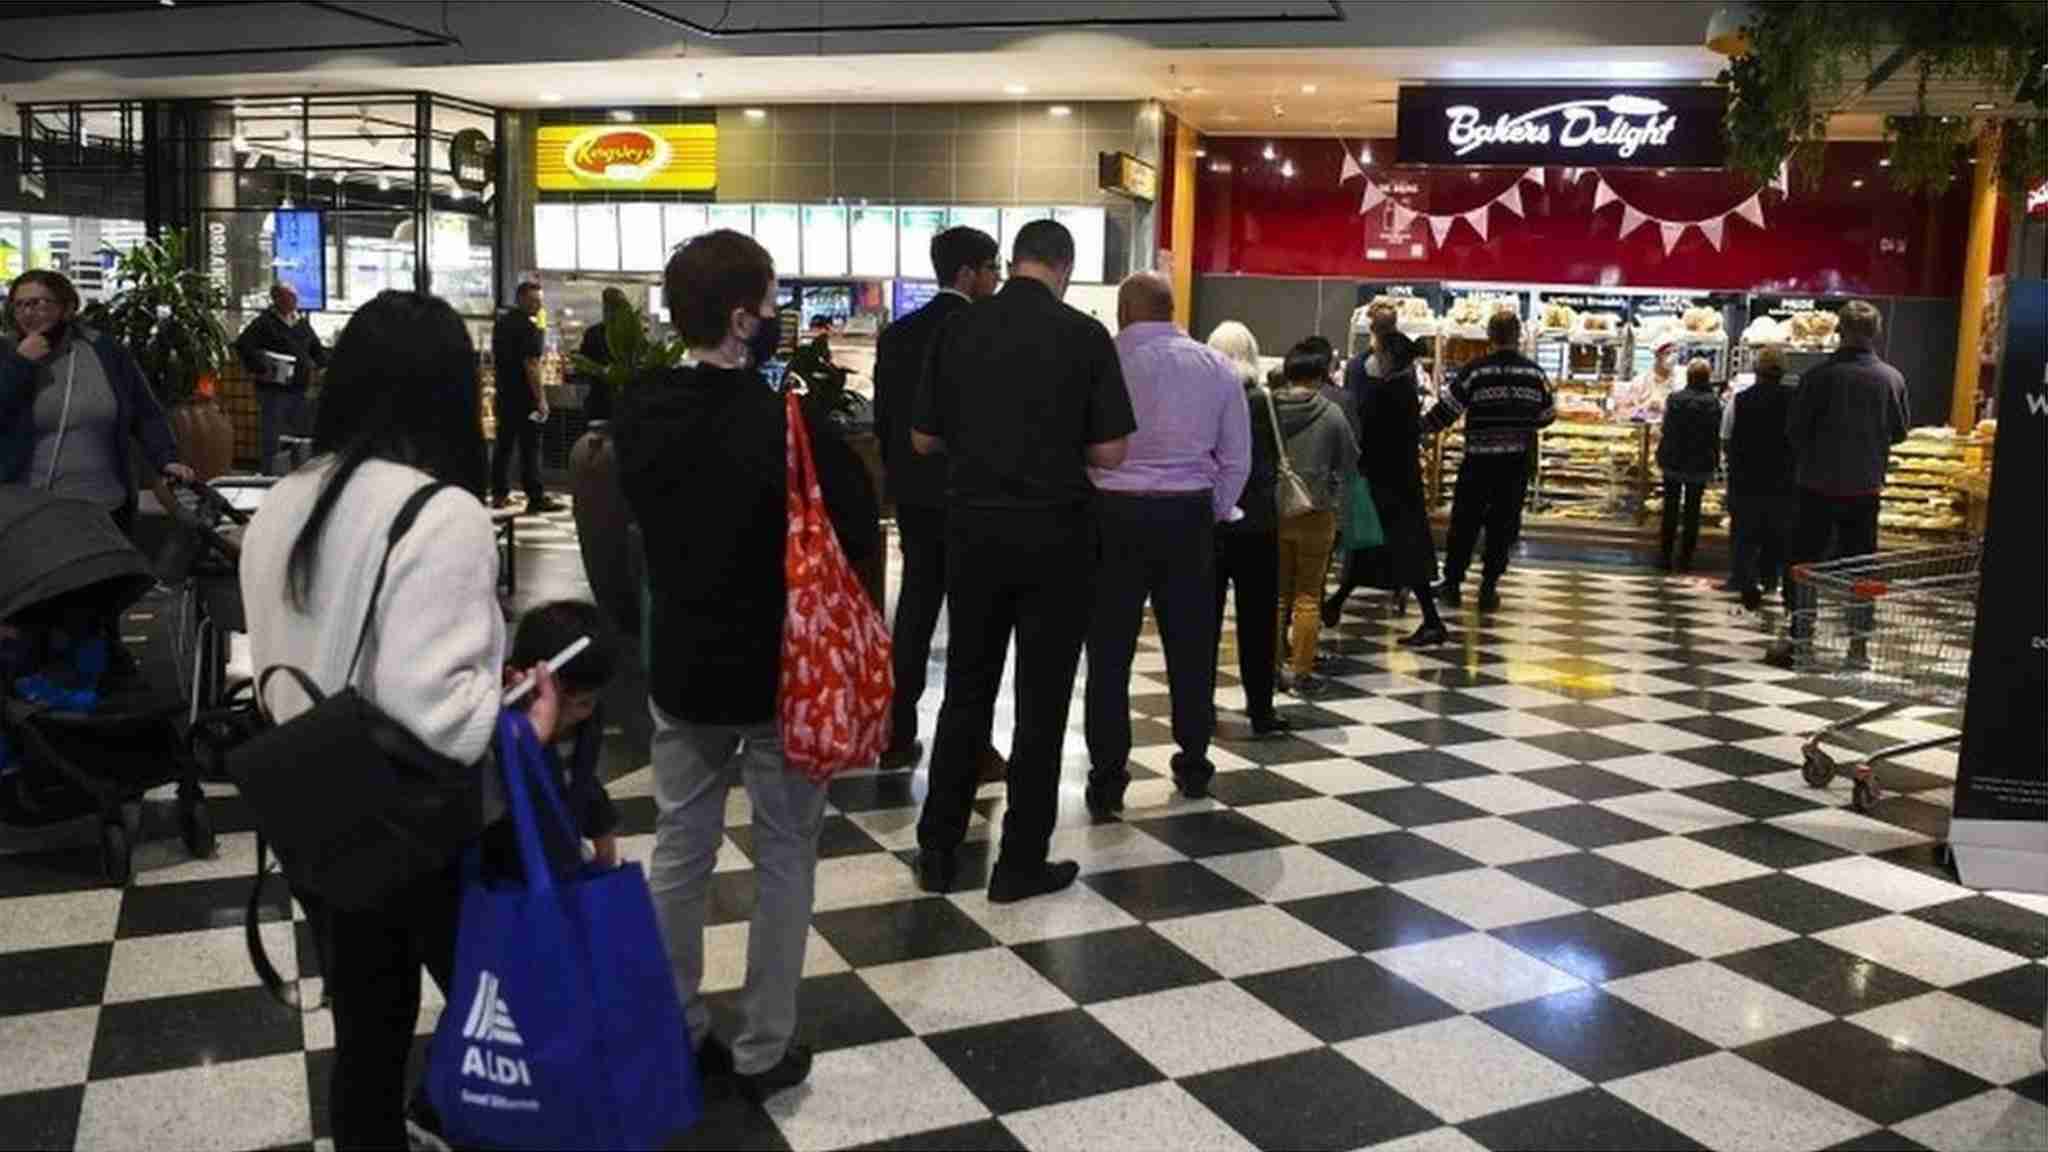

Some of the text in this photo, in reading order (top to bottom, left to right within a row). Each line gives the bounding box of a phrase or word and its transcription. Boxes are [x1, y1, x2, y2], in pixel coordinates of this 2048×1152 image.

[1446, 105, 1677, 158] Bakers Delight
[461, 1045, 532, 1086] ALDI
